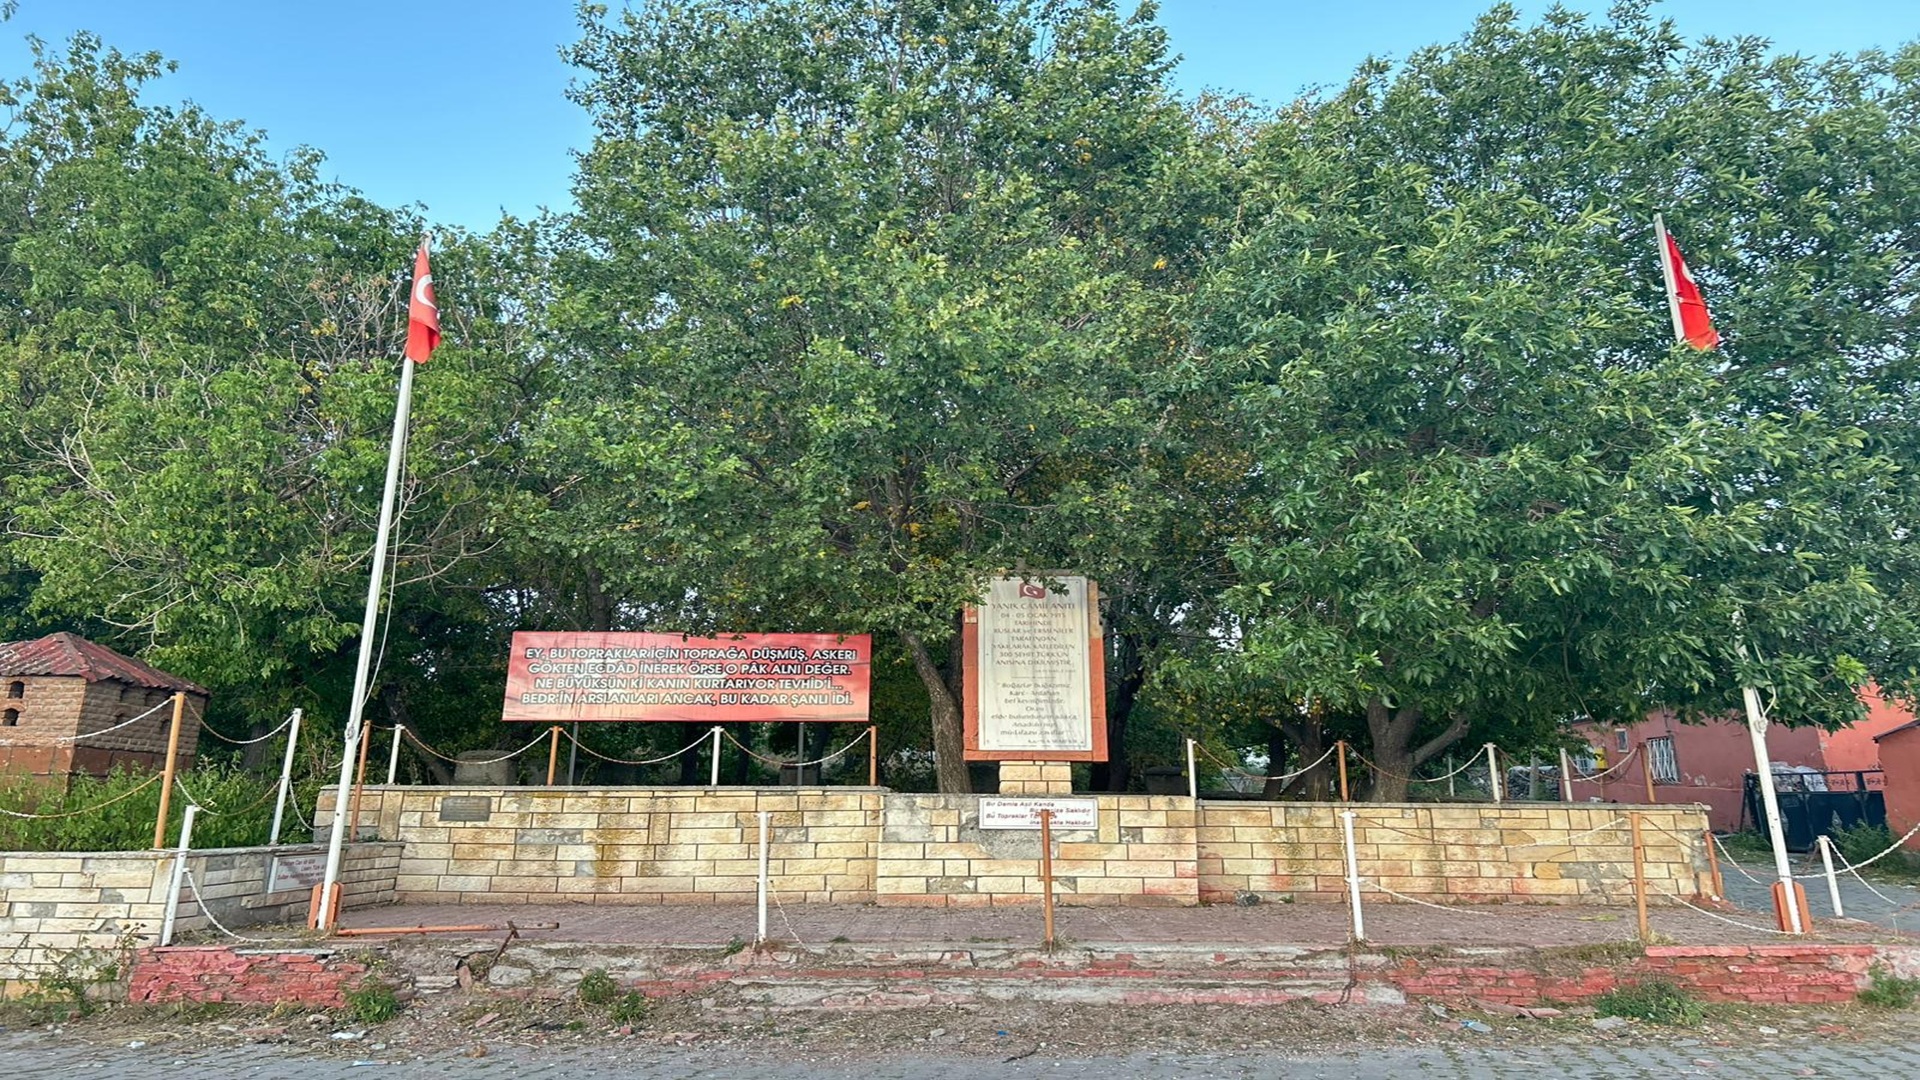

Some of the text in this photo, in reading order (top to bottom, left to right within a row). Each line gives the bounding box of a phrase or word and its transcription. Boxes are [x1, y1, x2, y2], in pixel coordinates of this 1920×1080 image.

[991, 602, 1019, 610] YANIK
[550, 648, 567, 659] BU
[571, 648, 650, 660] TOPRAKLAR
[651, 646, 680, 661] İÇİN
[683, 646, 748, 660] TOPRAĞA
[751, 647, 809, 662] DÜŞMÜŞ,
[528, 661, 851, 675] GÖKTEN ECDÂD İNEREK ÖPSE O PÂK ALNI DEĞER.
[535, 678, 553, 688] NE
[557, 676, 627, 689] BÜYÜKSÜN
[630, 676, 644, 689] Kİ
[647, 678, 690, 689] KANIN
[694, 678, 777, 690] KURTARIYOR
[522, 691, 573, 703] BEDR'İN
[577, 692, 659, 705] ARSLANLARI
[662, 693, 717, 706] ANCAK,
[720, 694, 737, 705] BU
[740, 694, 789, 705] KADAR
[791, 694, 828, 707] ŞANLI
